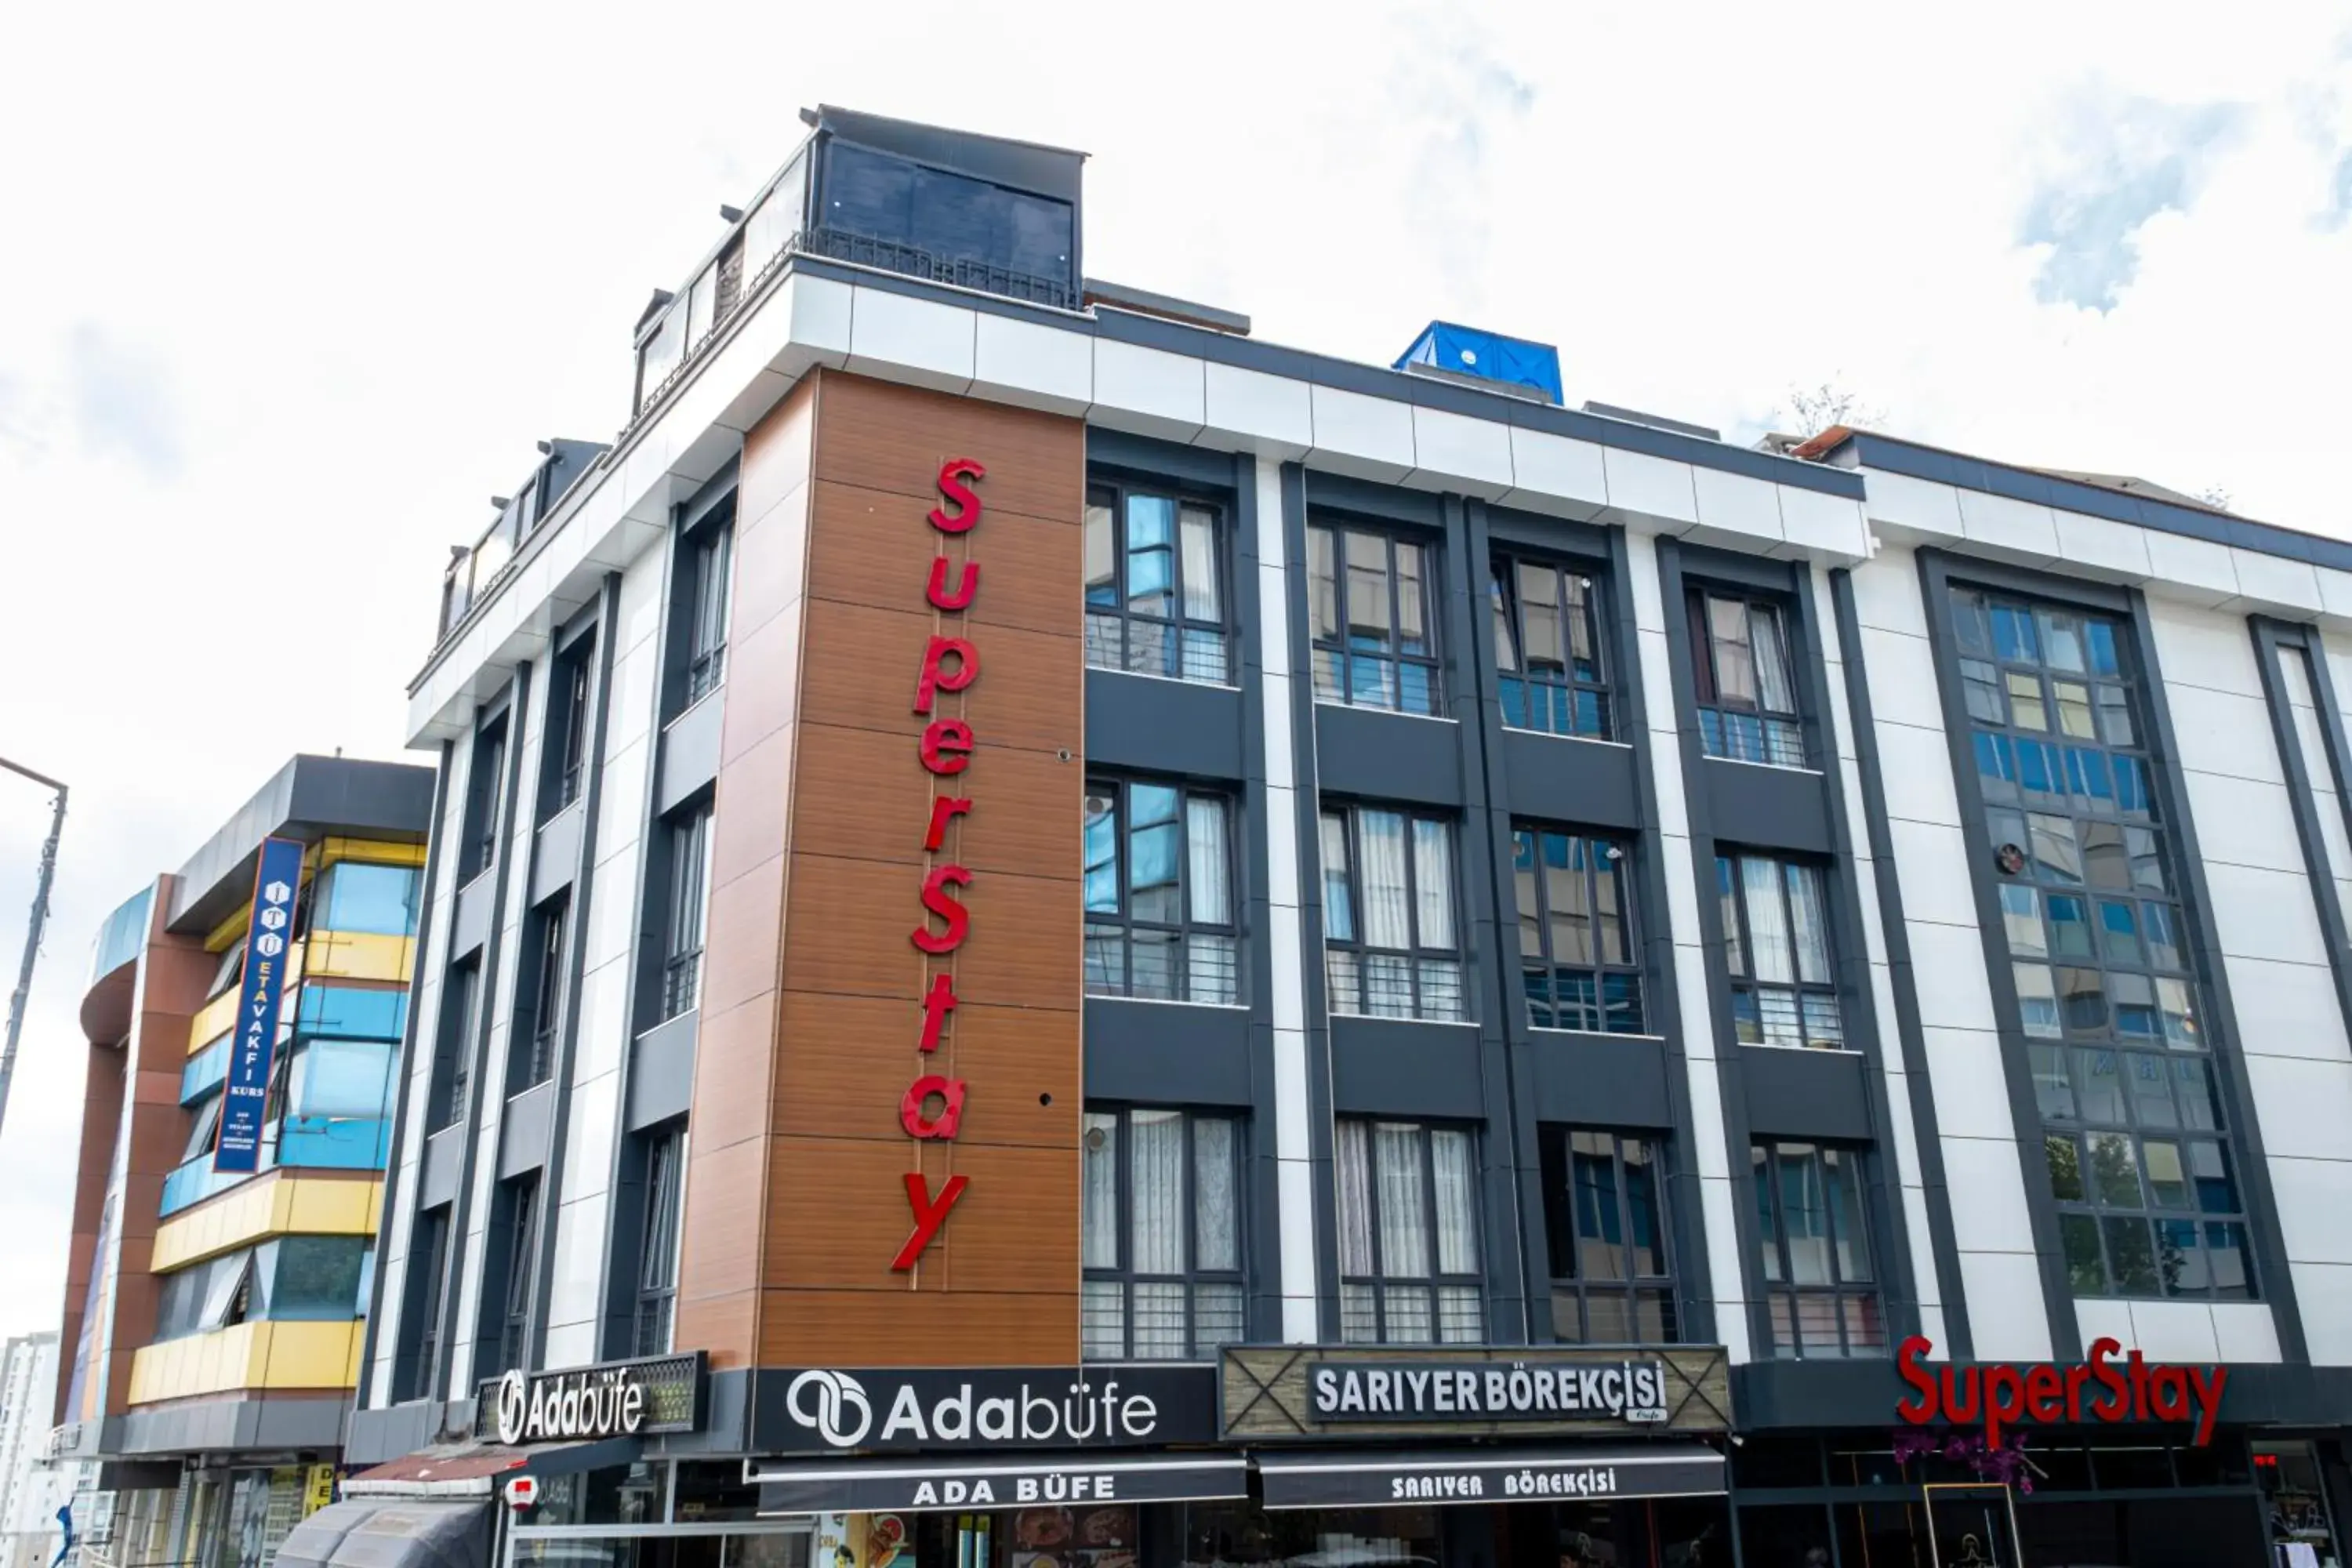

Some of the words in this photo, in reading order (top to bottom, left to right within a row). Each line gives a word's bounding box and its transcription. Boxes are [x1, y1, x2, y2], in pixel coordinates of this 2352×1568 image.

[891, 458, 986, 1270] SuperStay
[230, 1086, 264, 1097] KURS
[525, 1367, 645, 1437] Adabüfe
[880, 1382, 1157, 1440] Adabüfe
[1316, 1370, 1480, 1412] SARIYER
[1896, 1334, 2227, 1451] SuperStay
[913, 1481, 995, 1504] ADA
[1017, 1474, 1115, 1501] BÜFE
[1392, 1475, 1483, 1497] SARIYER
[1504, 1468, 1617, 1496] BÖREKÇİSİ
